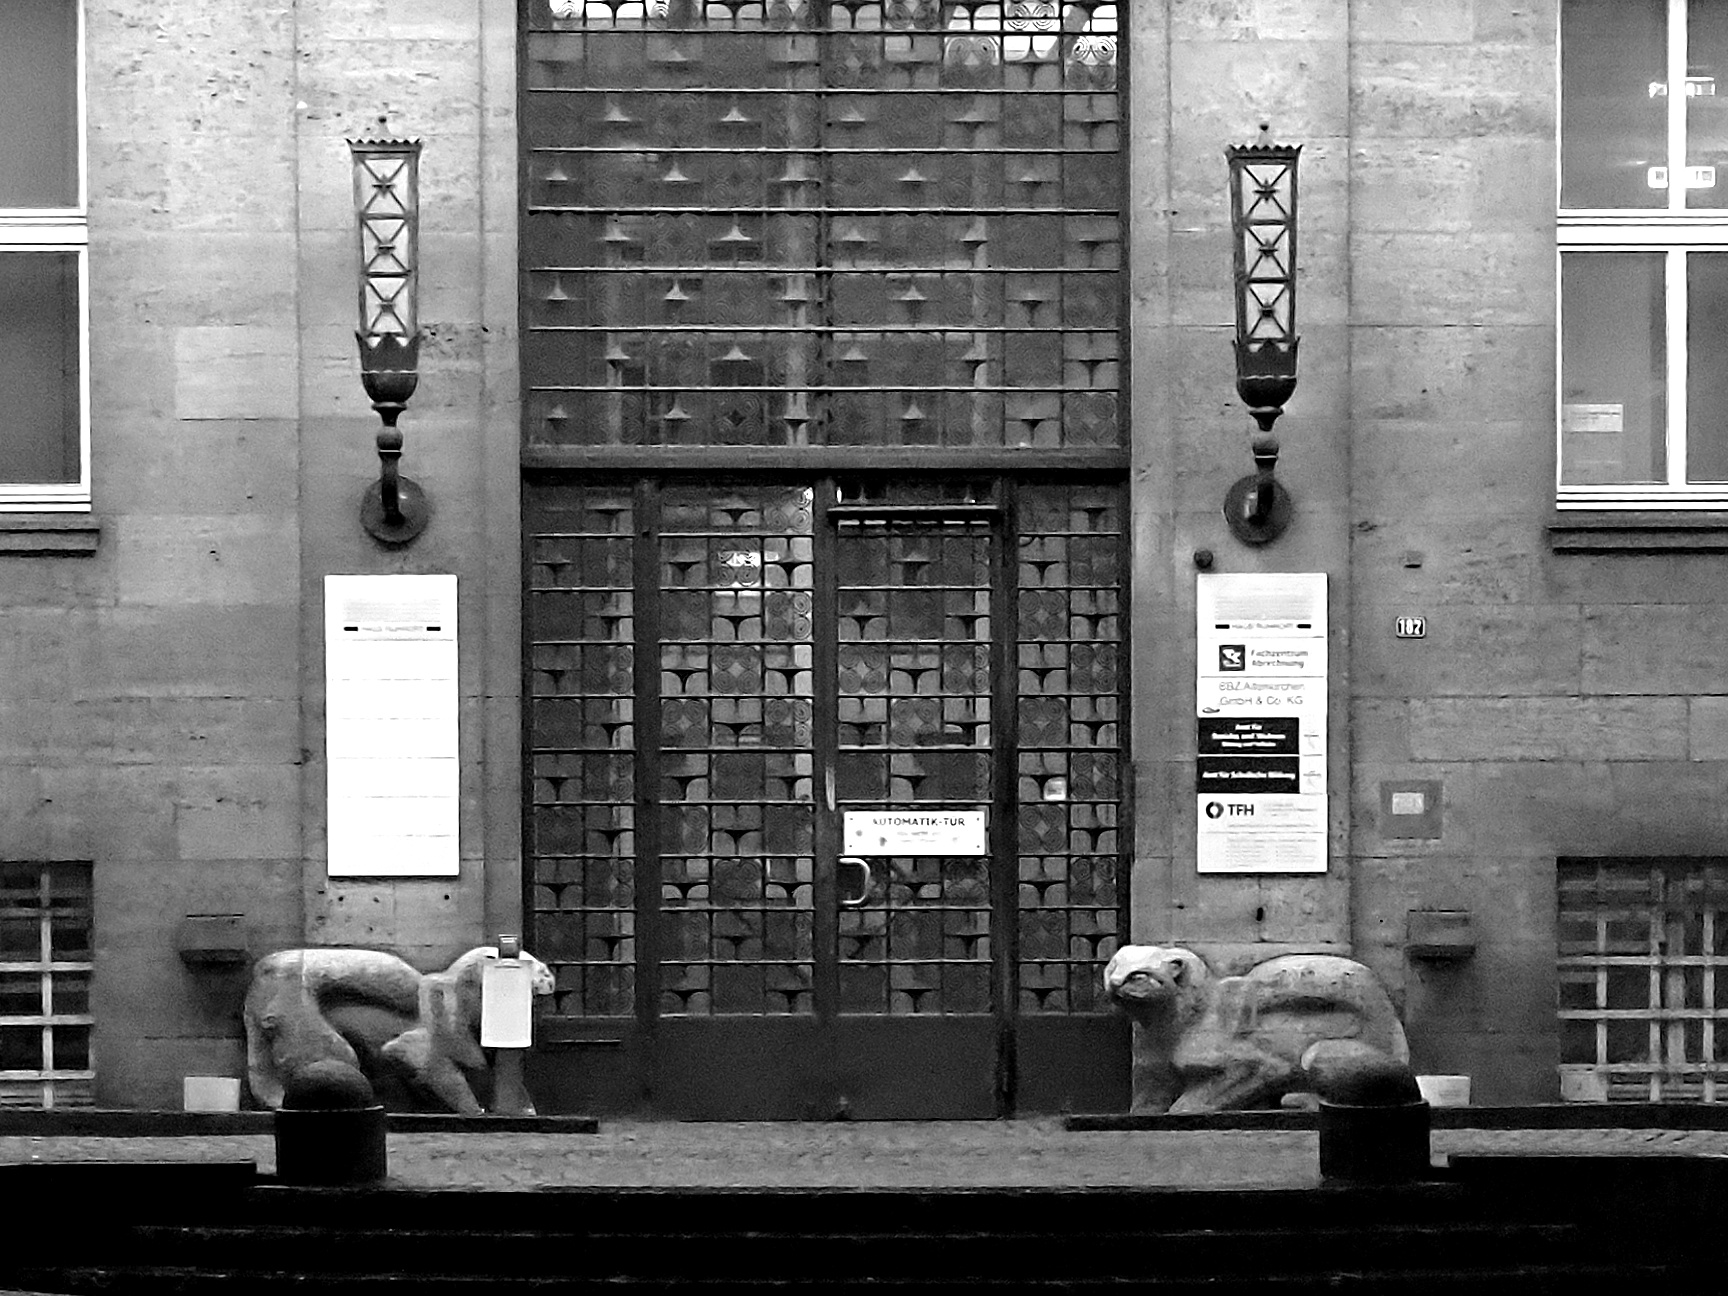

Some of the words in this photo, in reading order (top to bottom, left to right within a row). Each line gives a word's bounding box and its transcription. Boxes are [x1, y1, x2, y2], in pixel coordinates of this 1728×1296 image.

[1399, 618, 1422, 635] 187
[1255, 695, 1262, 705] &
[1287, 695, 1303, 705] KG
[1227, 803, 1255, 816] TFH
[873, 815, 965, 826] AUTOMATIK-TÜR
